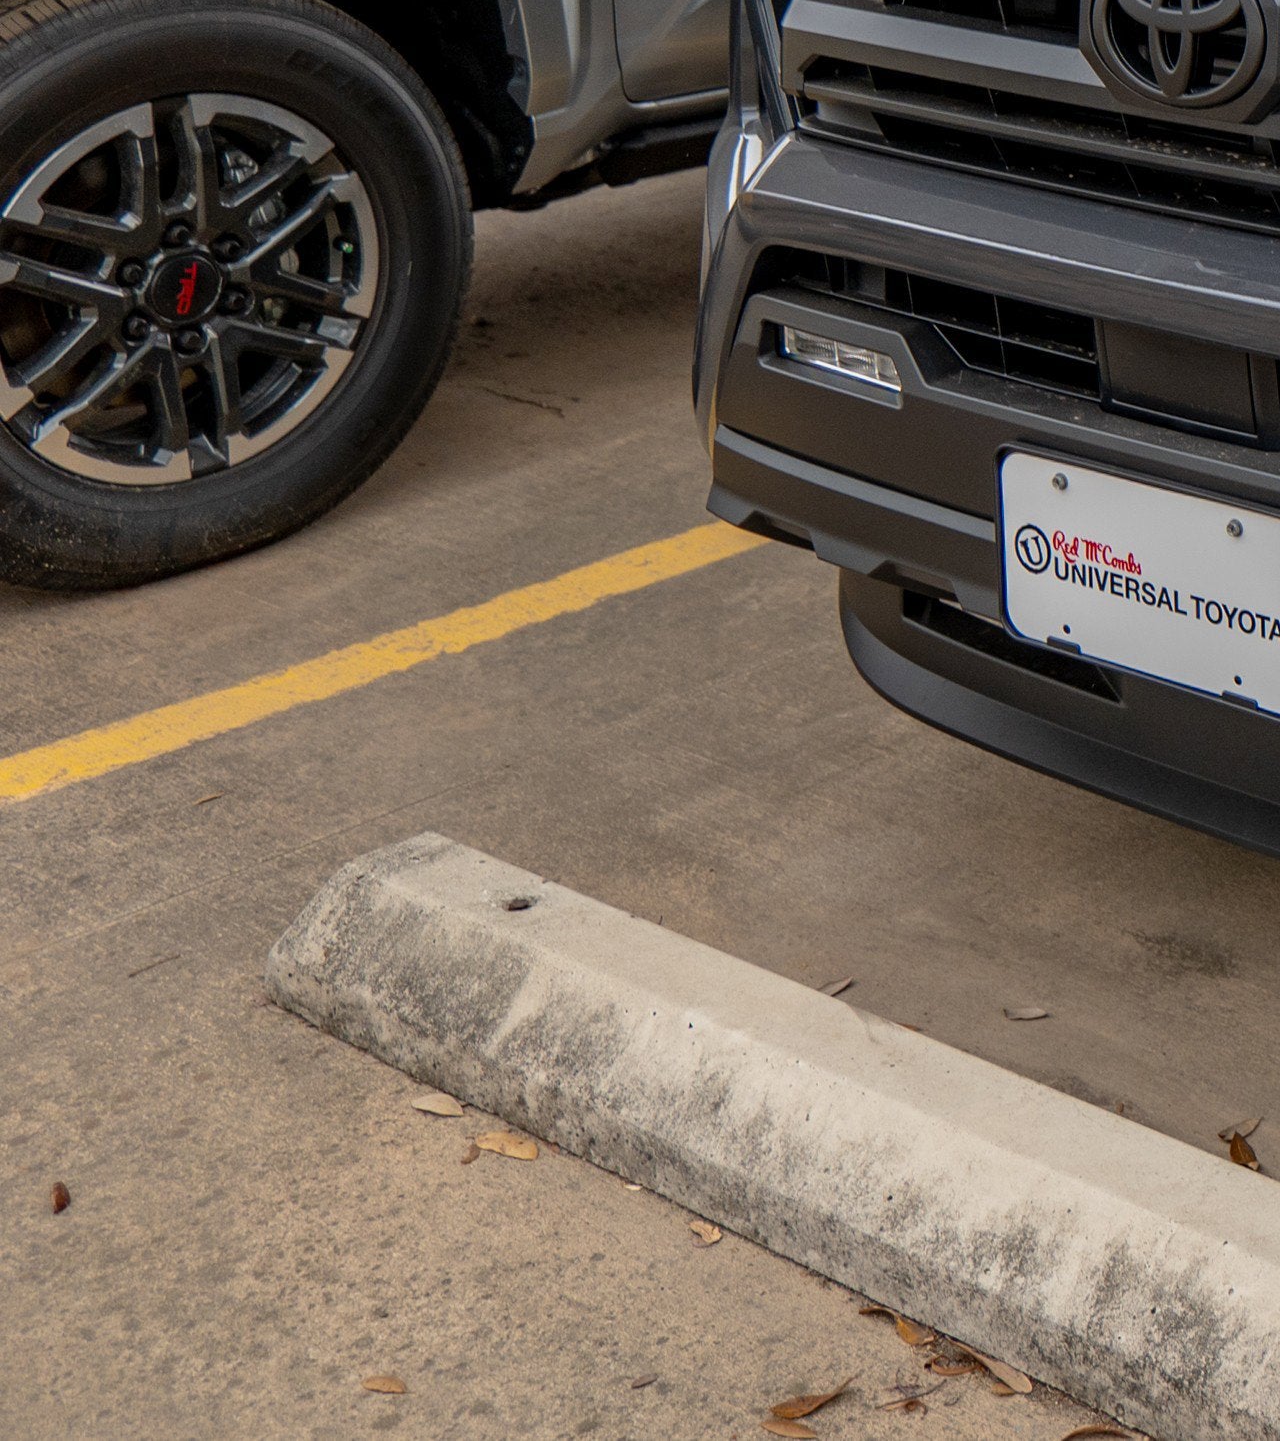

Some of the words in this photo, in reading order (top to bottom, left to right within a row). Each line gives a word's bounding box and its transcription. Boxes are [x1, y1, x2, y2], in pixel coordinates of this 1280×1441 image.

[177, 262, 198, 315] TRD
[1052, 531, 1080, 565] Red
[1082, 539, 1142, 576] McCombs
[1054, 556, 1188, 617] UNIVERSAL
